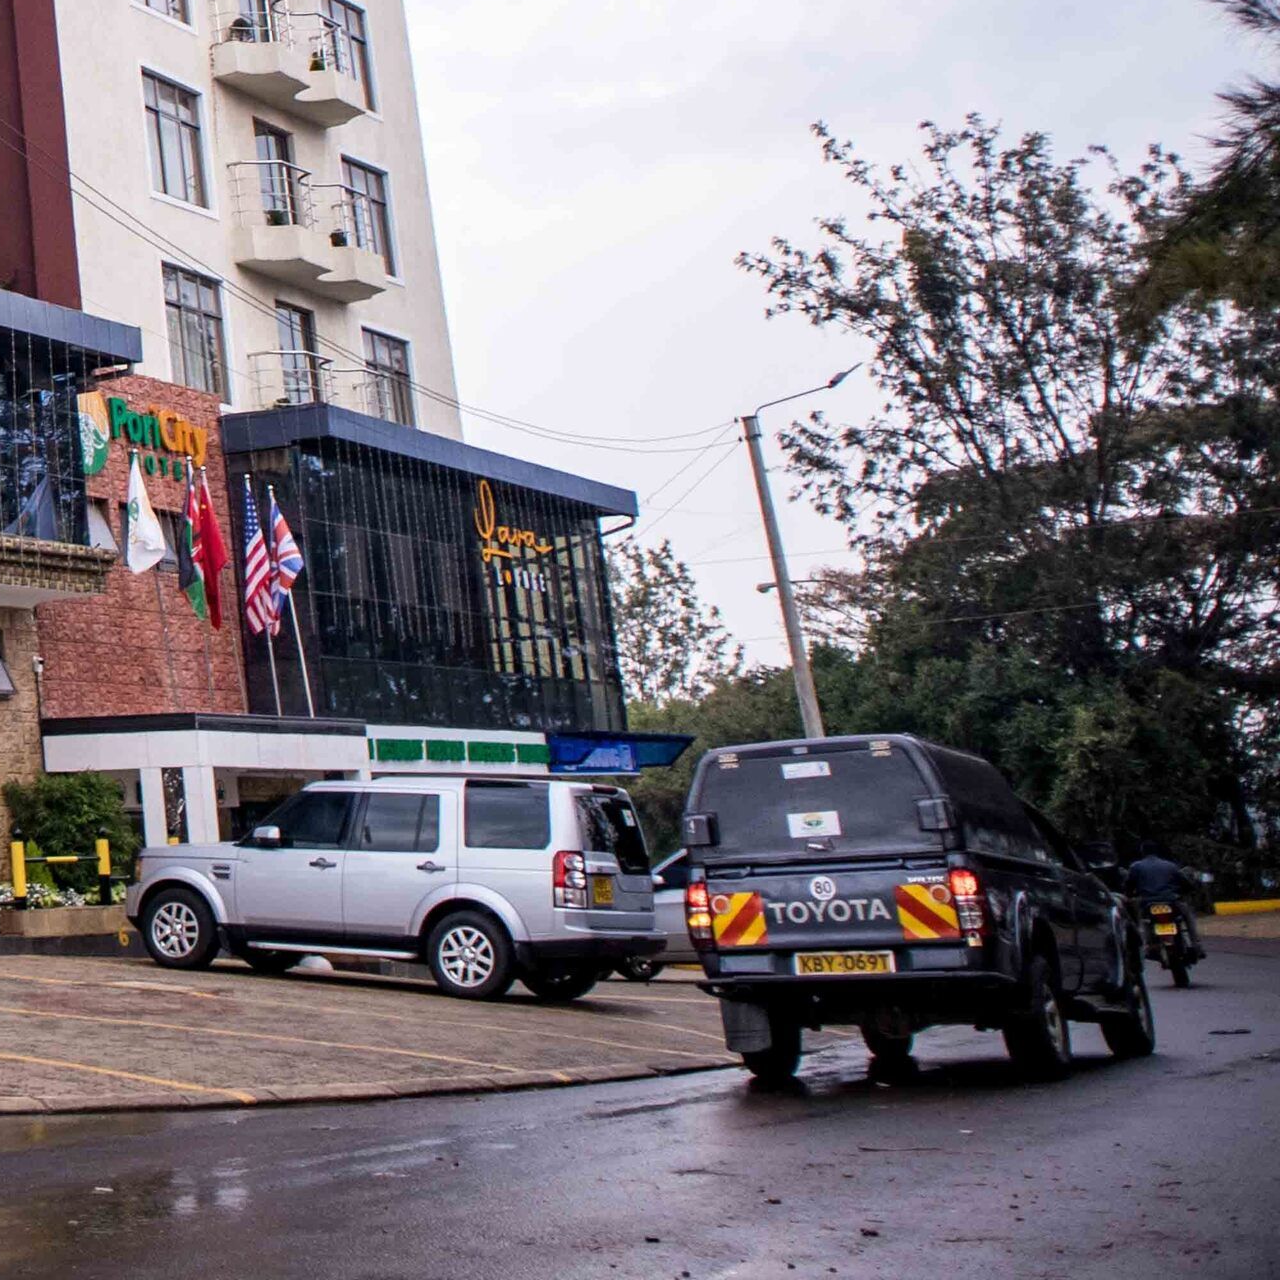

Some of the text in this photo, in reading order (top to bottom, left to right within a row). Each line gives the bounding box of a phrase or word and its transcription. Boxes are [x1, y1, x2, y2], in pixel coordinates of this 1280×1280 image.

[108, 397, 208, 468] PoriCity
[474, 480, 554, 562] Lava
[768, 899, 893, 924] TOYOTA
[814, 882, 832, 895] 80
